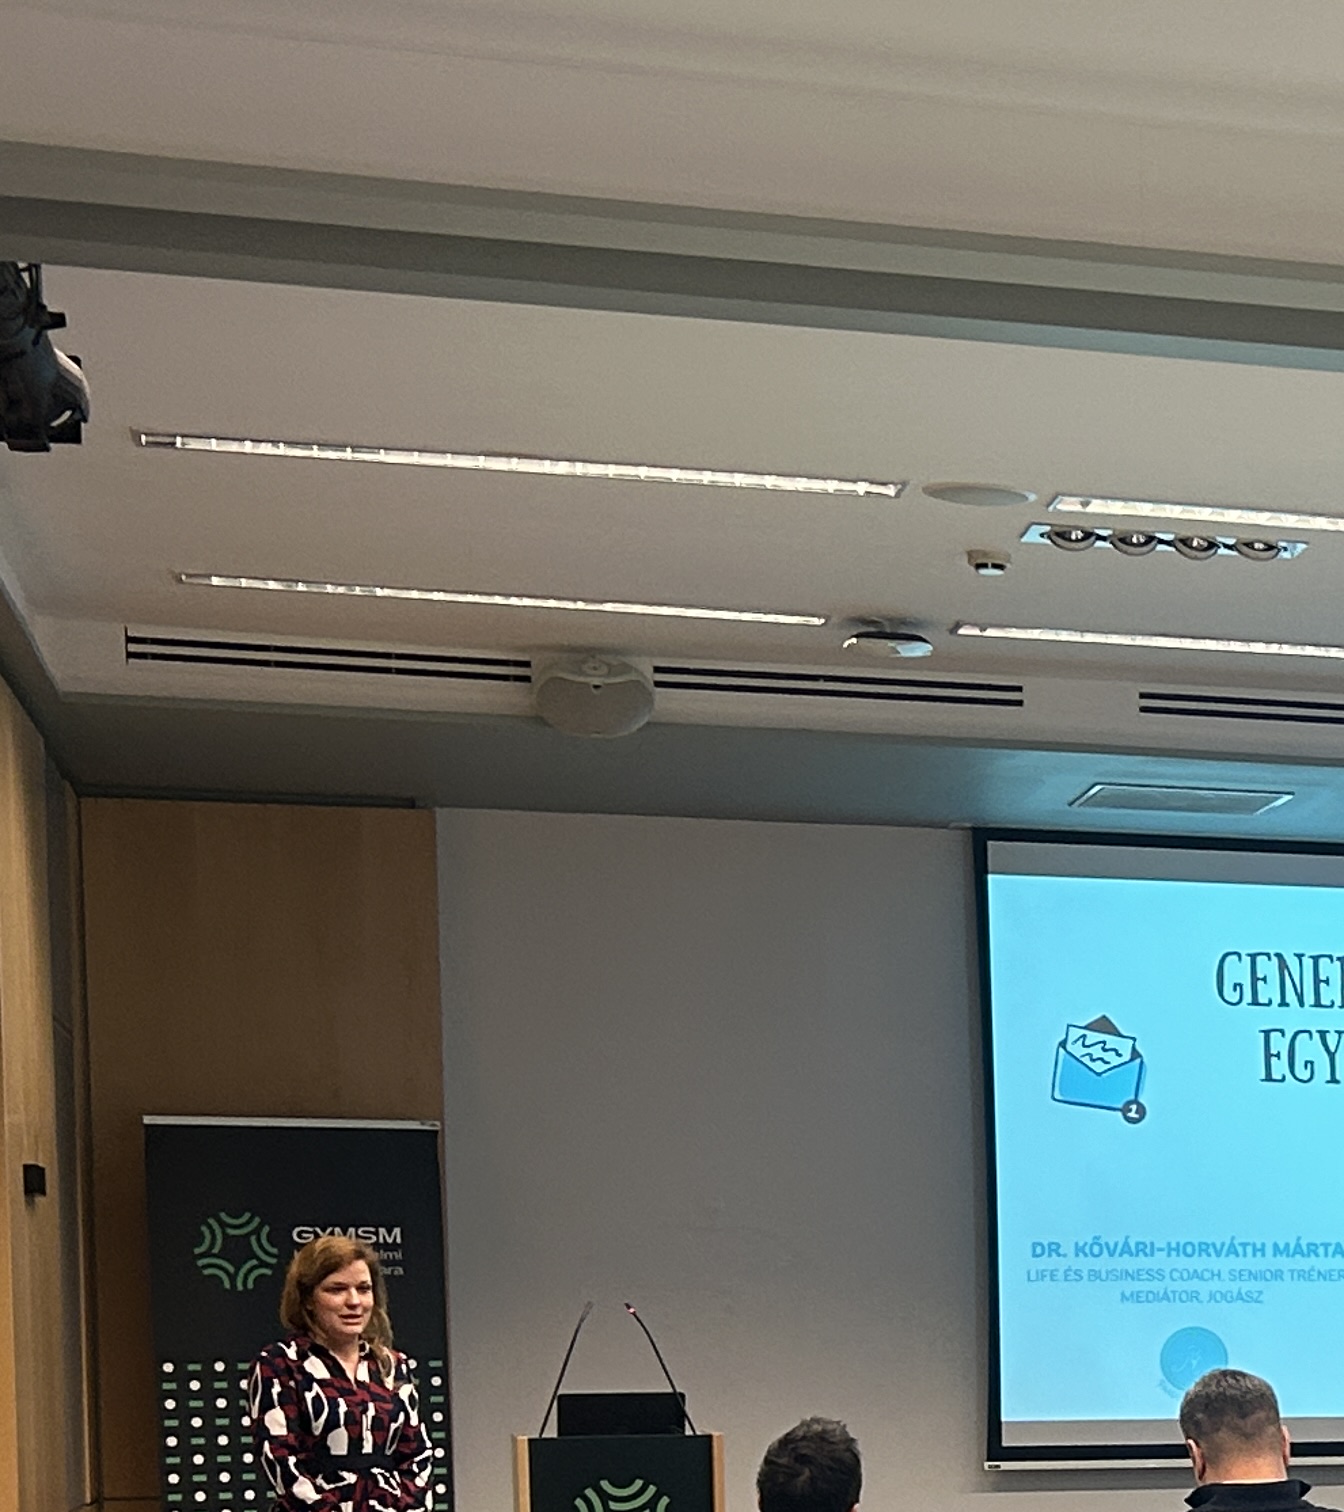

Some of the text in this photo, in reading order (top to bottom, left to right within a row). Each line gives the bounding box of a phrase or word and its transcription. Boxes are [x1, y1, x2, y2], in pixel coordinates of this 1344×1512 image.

[292, 1226, 402, 1244] GYMSM
[1031, 1241, 1067, 1259] DR.
[1074, 1235, 1267, 1259] KŐVÁRI-HORVÁTH
[1026, 1268, 1059, 1283] LIFE
[1063, 1265, 1084, 1283] ÉS
[1087, 1268, 1166, 1283] BUSINESS
[1228, 1268, 1284, 1283] SENIOR
[1206, 1288, 1265, 1304] JOGÁSZ
